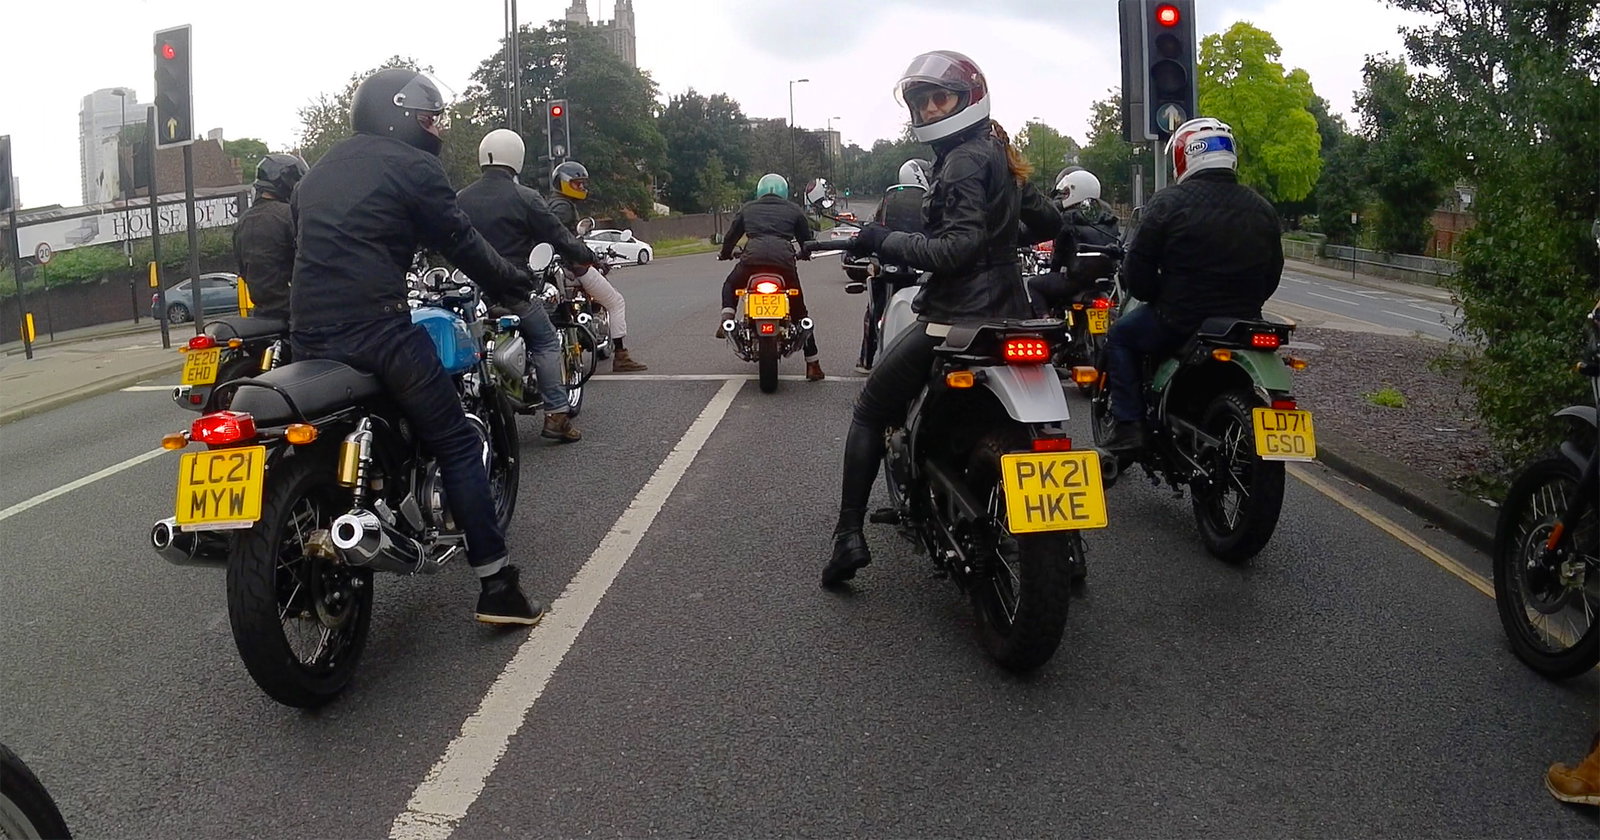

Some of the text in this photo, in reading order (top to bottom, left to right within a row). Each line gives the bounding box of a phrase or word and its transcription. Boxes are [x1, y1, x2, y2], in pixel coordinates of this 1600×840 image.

[1185, 141, 1204, 155] Arai
[112, 209, 182, 235] HOUSE
[194, 204, 215, 223] OF
[39, 248, 49, 259] 20
[754, 295, 780, 305] LE21
[186, 351, 217, 366] PE20
[1261, 411, 1306, 432] LD71
[1266, 434, 1306, 454] GSO
[189, 452, 253, 485] LC21
[1016, 459, 1089, 490] PK21
[189, 486, 246, 519] MYW
[1024, 491, 1090, 523] HKE
